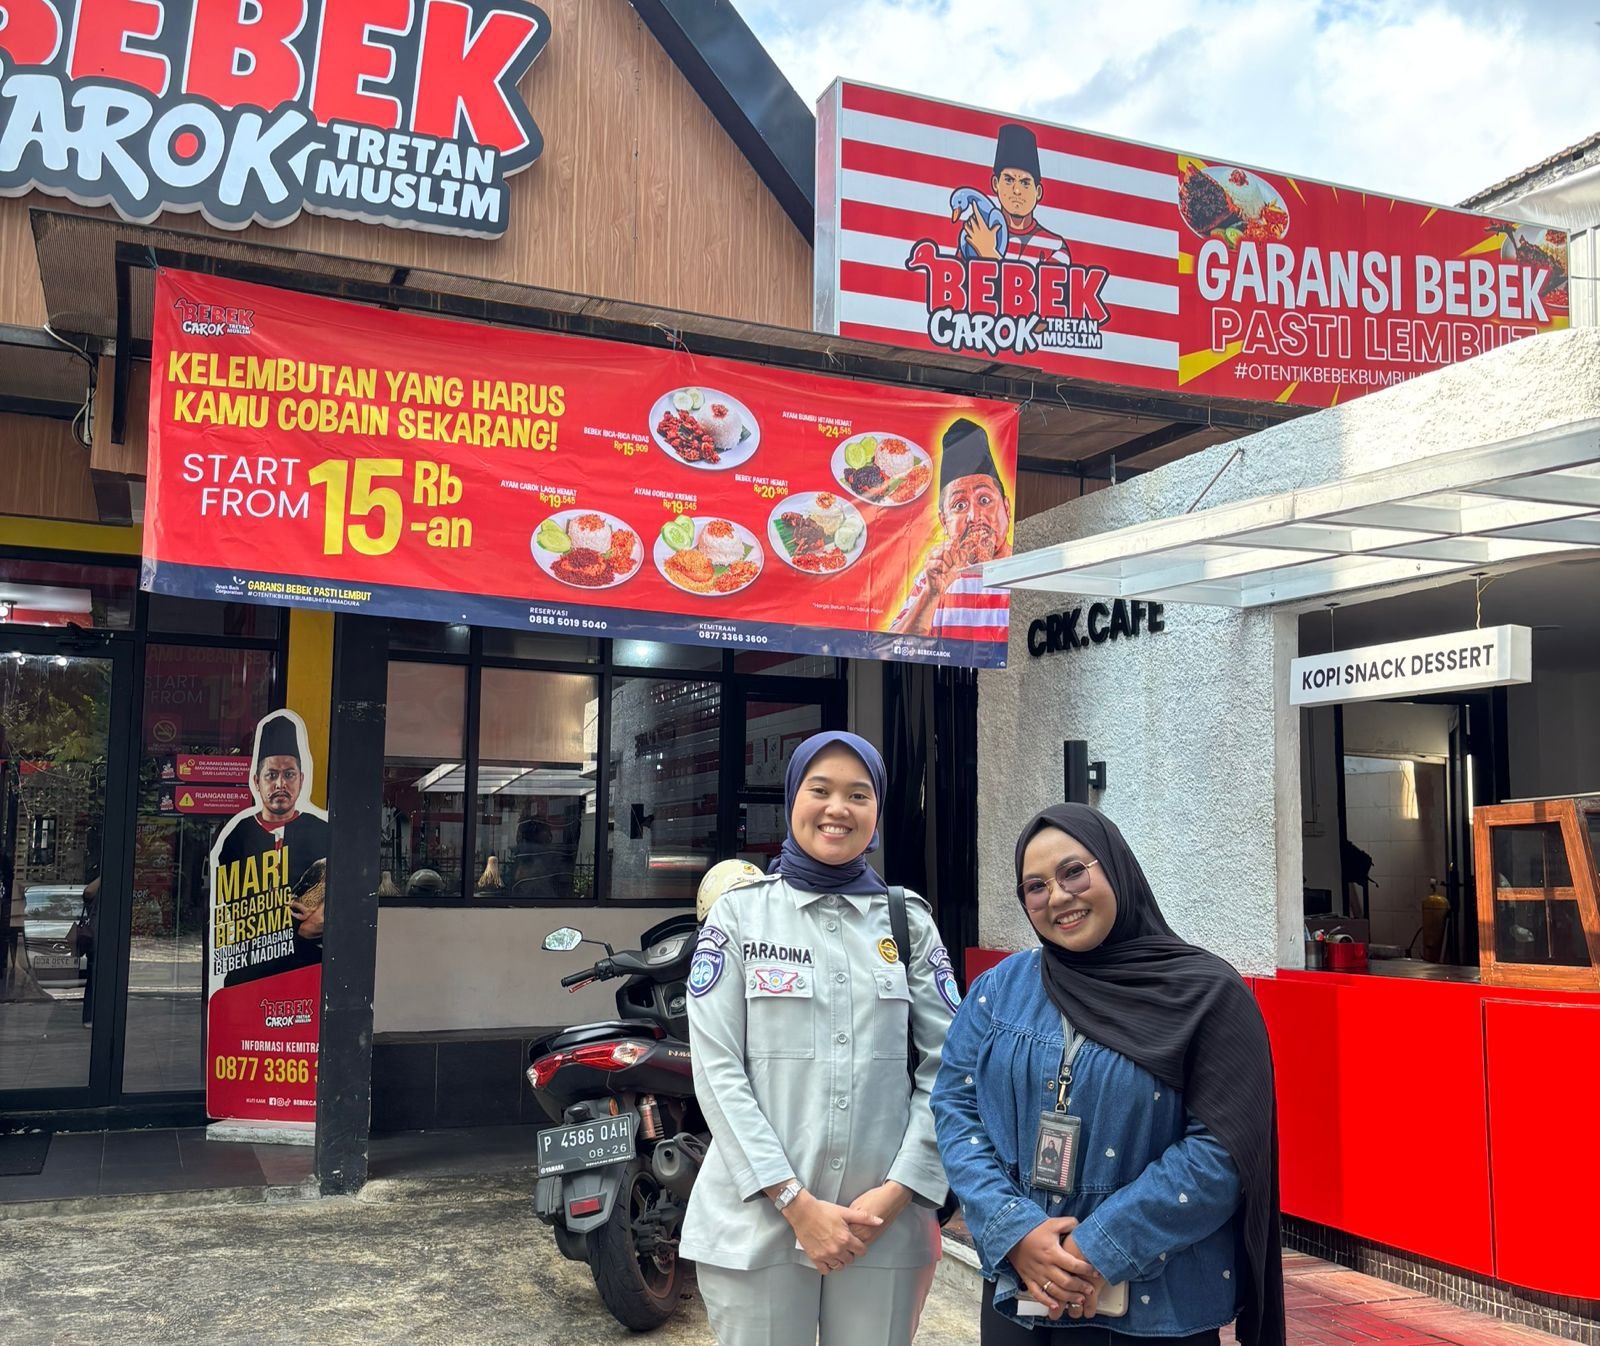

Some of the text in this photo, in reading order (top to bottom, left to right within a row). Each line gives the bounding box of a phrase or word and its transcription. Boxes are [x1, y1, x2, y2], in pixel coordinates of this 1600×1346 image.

[0, 73, 308, 206] AROK
[331, 122, 496, 184] TRETAN
[314, 159, 501, 223] MUSLIM
[928, 257, 1109, 323] BEBEK
[1198, 240, 1550, 322] GARANSI BEBEK
[182, 303, 254, 328] BEBEK
[182, 320, 226, 337] CAROK
[930, 308, 1040, 354] CAROK
[1046, 317, 1099, 335] TRETAN
[1042, 330, 1102, 349] MUSLIM
[1211, 306, 1352, 360] PASTI
[168, 349, 566, 417] KELEMBUTAN YANG HARUS
[173, 388, 559, 452] KAMU COBAIN SEKARANG!
[182, 452, 300, 487] START
[413, 459, 464, 507] Rb
[500, 479, 518, 489] AYAM
[201, 487, 310, 519] FROM
[307, 457, 404, 557] 15
[634, 487, 651, 497] AYAM
[410, 516, 472, 549] -an
[247, 580, 372, 601] GARANSI BEBEK PASTI LEMBUT
[529, 607, 569, 616] RESERVASI
[529, 615, 608, 630] 0858 5019 5040
[699, 623, 737, 632] KEMITRAAN
[1027, 598, 1166, 658] CRK.CAFE
[698, 631, 768, 644] 0877 3366 3600
[1302, 644, 1495, 690] KOPI SNACK DESSERT
[217, 845, 289, 905] MARI
[215, 886, 292, 925] BERGABUNG
[214, 927, 294, 961] SINDIKAT PEDAGANG
[215, 906, 293, 950] BERSAMA
[215, 939, 295, 976] BEBEK MADURA
[743, 942, 813, 965] FARADINA
[263, 999, 314, 1017] BEBEK
[265, 1015, 295, 1027] CAROK
[241, 1040, 319, 1053] INFORMASI KEMITRA
[215, 1055, 259, 1081] 0877
[264, 1058, 309, 1084] 3366
[293, 1099, 317, 1107] BEBEKCA
[544, 1136, 552, 1152] P
[561, 1128, 595, 1148] 4586
